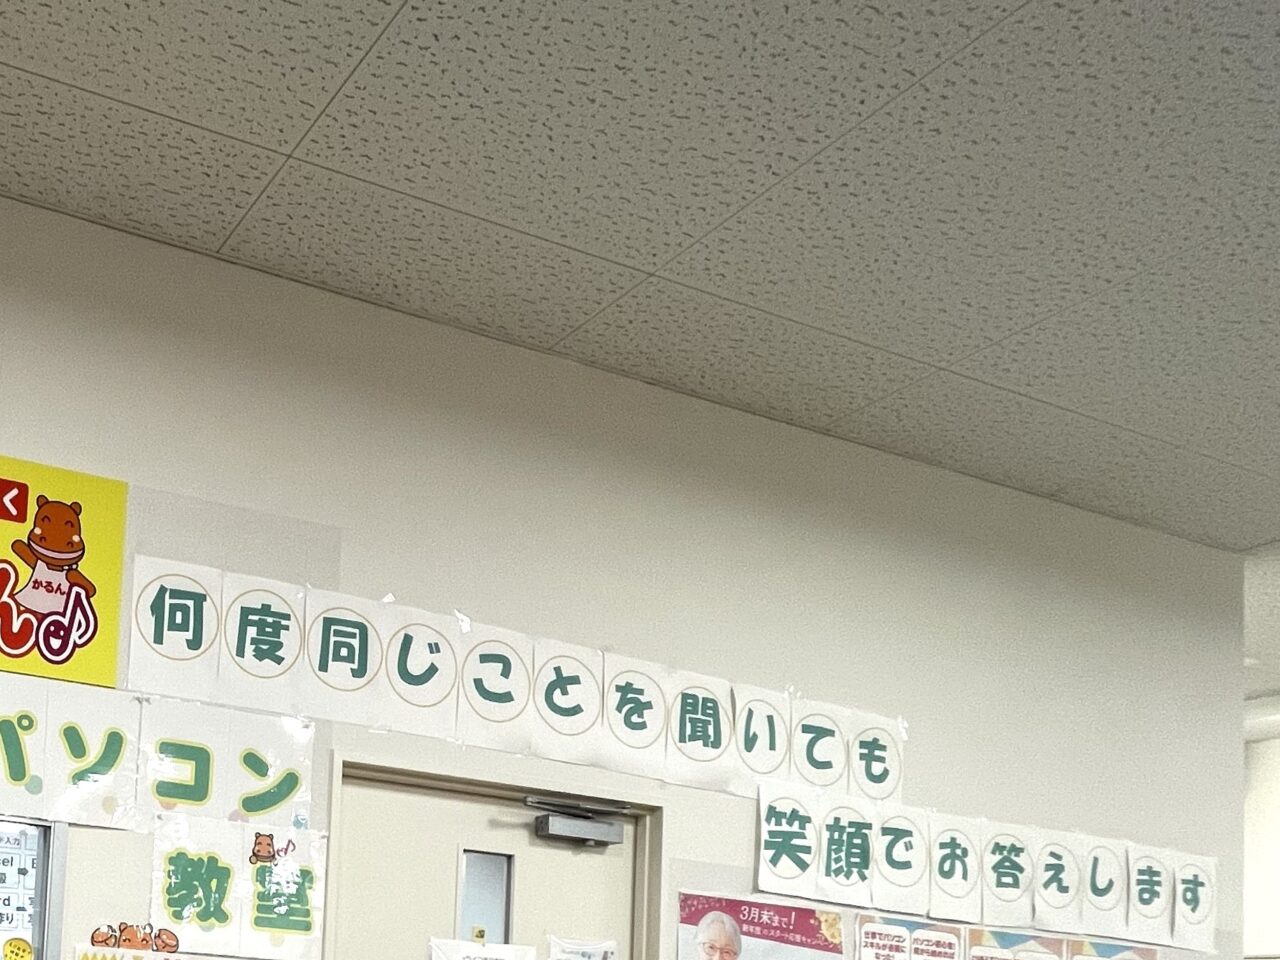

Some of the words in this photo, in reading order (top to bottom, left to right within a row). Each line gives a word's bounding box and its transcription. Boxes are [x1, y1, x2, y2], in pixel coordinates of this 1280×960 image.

[31, 578, 66, 595] かるん
[148, 582, 891, 785] 何度同じことを聞いても
[160, 844, 317, 932] 教室
[762, 804, 1206, 913] 笑顔でお答えします
[740, 905, 796, 929] 3月末まで！
